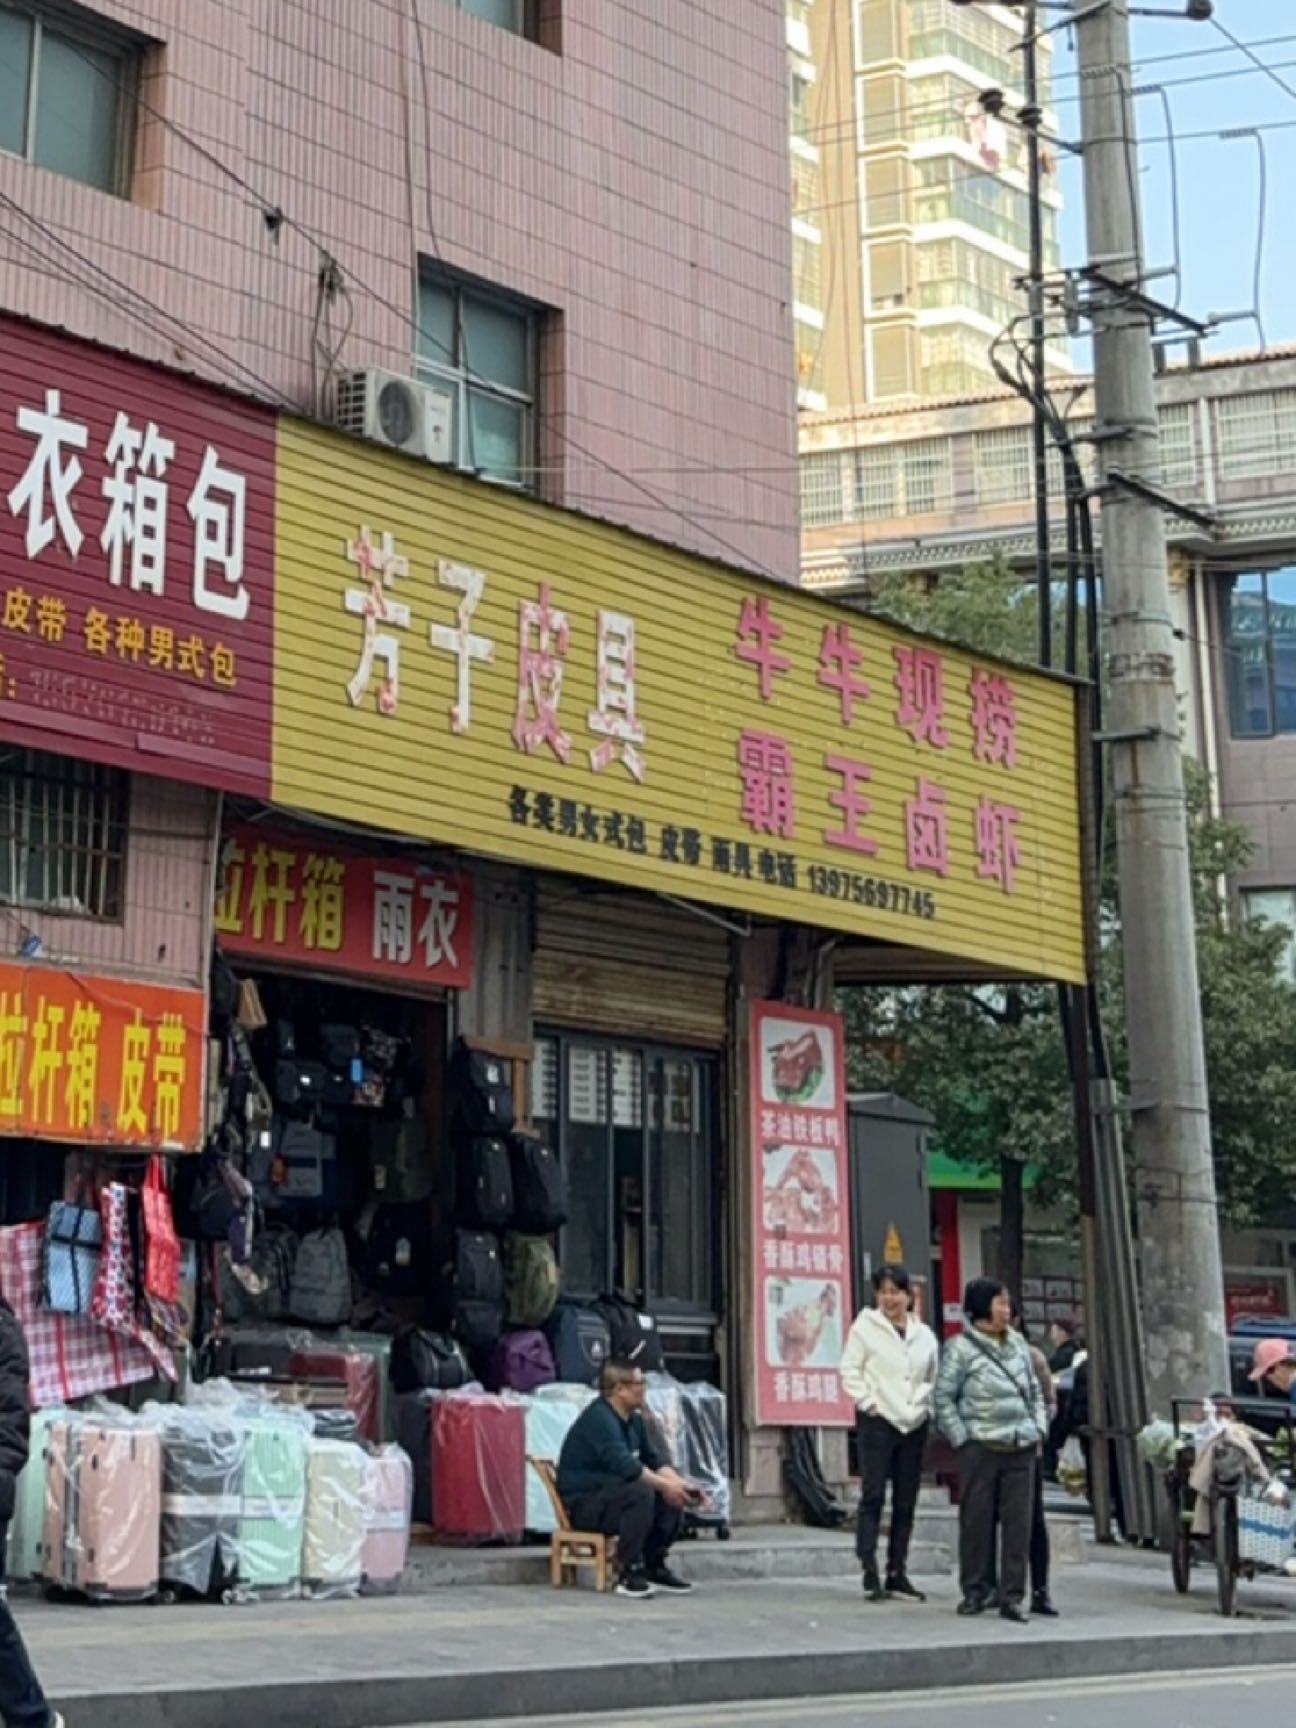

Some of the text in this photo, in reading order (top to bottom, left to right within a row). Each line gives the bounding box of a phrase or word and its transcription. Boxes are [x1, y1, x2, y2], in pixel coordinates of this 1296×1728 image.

[2, 587, 67, 642] 皮带
[83, 606, 238, 688] 各种男式包
[344, 524, 646, 784] 芳子皮具
[735, 592, 1017, 769] 牛牛现捞
[737, 727, 1022, 895] 霸王卤虾
[372, 870, 459, 969] 雨衣
[115, 1005, 188, 1143] 皮带
